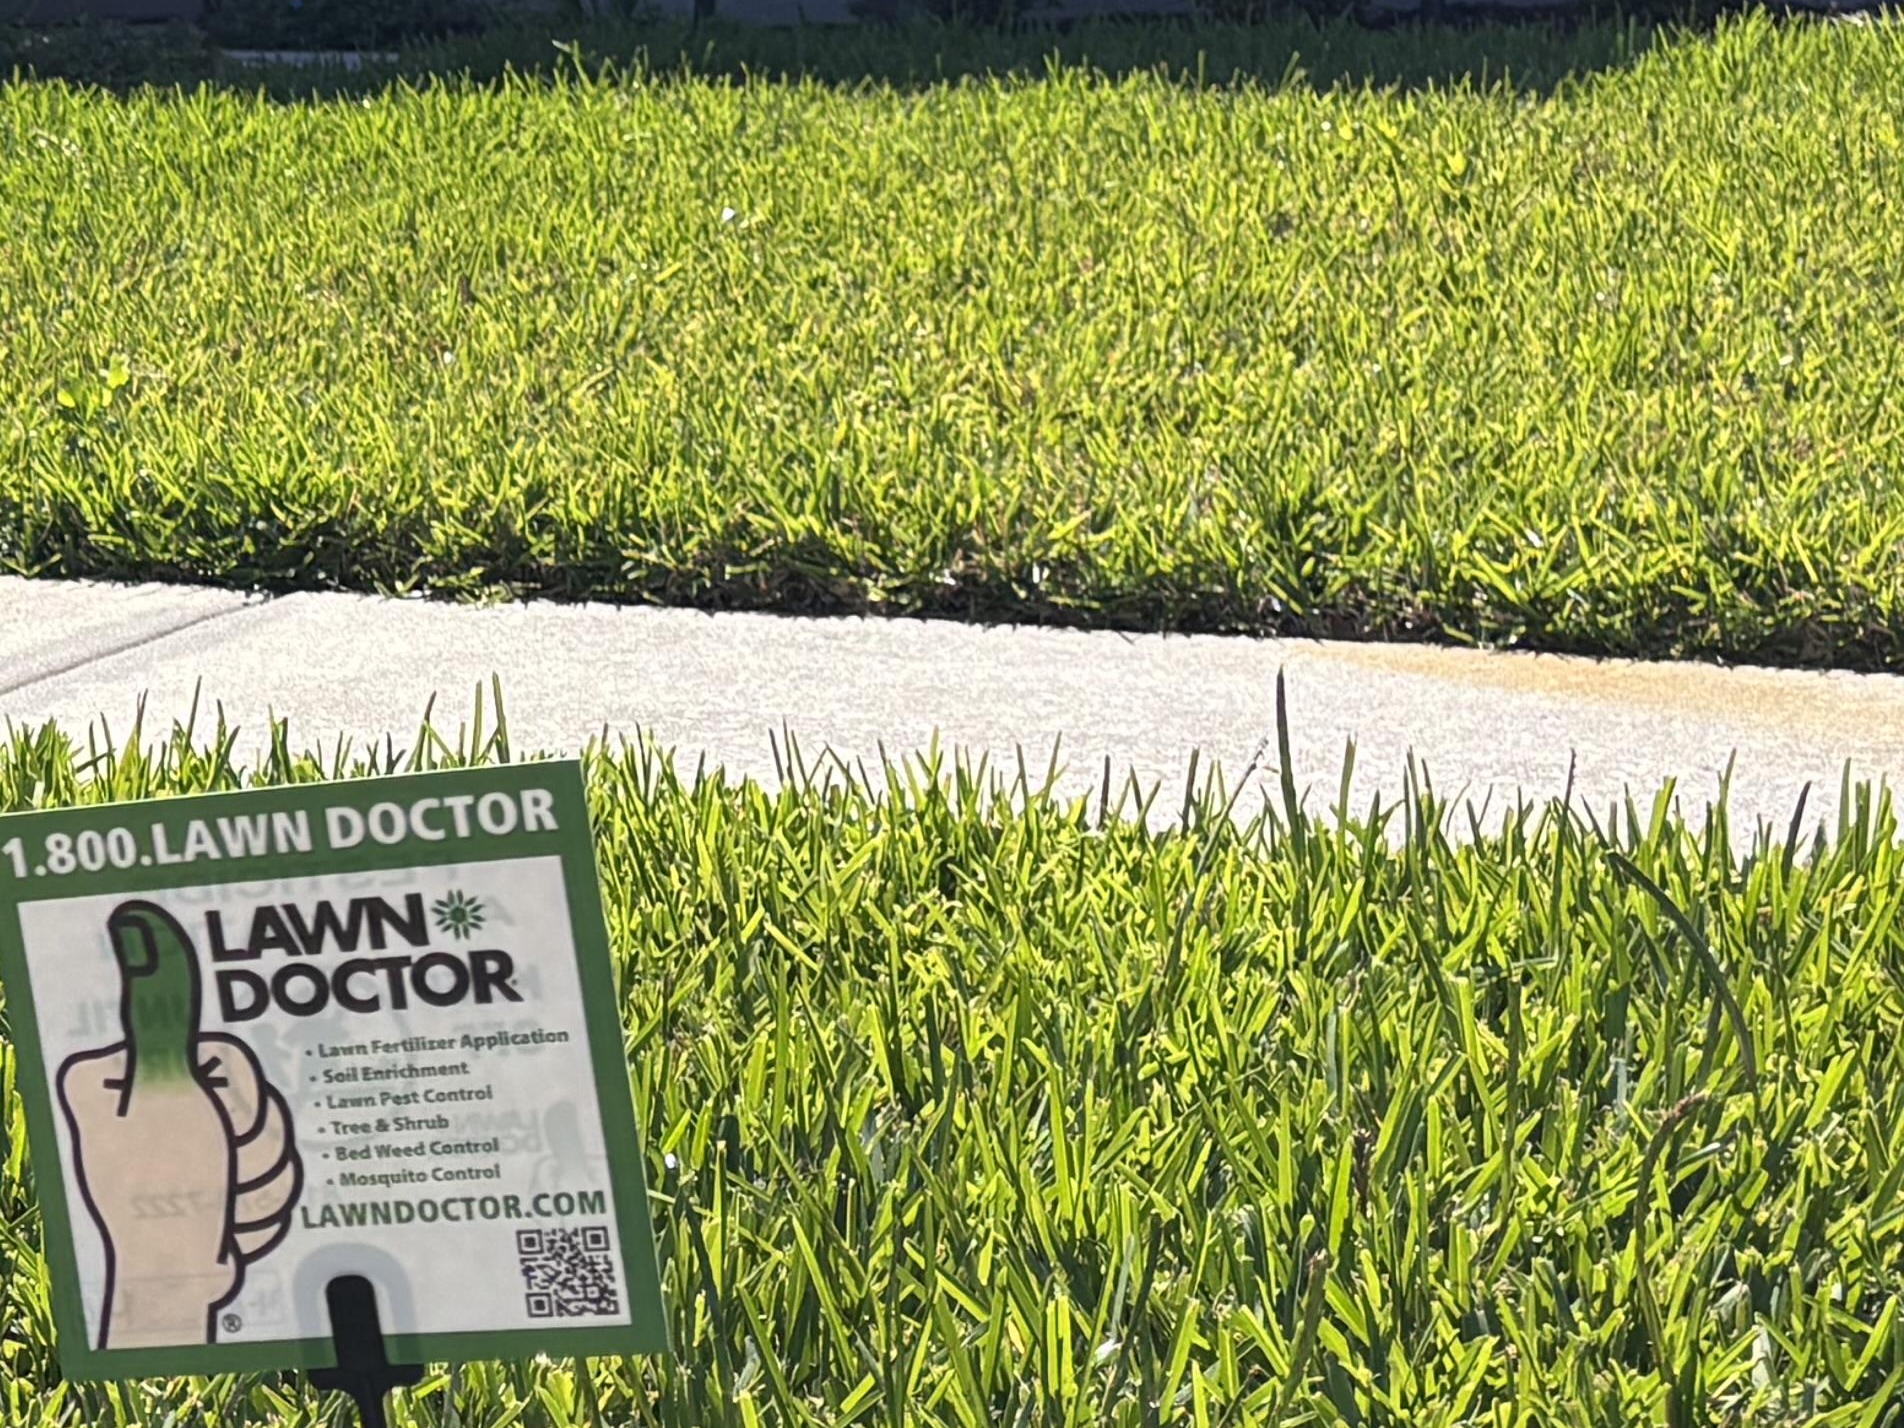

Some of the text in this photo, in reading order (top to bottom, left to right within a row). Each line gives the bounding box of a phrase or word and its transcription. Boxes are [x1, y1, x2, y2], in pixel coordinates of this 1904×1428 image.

[2, 788, 558, 878] 1.800.LAWN DOCTOR
[206, 893, 429, 962] LAWN
[216, 949, 524, 1022] DOCTOR
[318, 1043, 367, 1058] Lawn
[372, 1035, 456, 1054] Fertilizer
[460, 1029, 569, 1050] Application
[323, 1061, 470, 1084] Soil Enrichment
[326, 1084, 493, 1109] Lawn Pest Control
[332, 1120, 372, 1134] Tree
[375, 1117, 389, 1132] &
[392, 1114, 449, 1130] Shrub
[335, 1144, 372, 1160] Bed
[375, 1139, 426, 1158] Weed
[429, 1137, 500, 1155] Control
[339, 1163, 501, 1187] Mosquito Control
[301, 1190, 607, 1229] LAWNDOCTOR.COM
